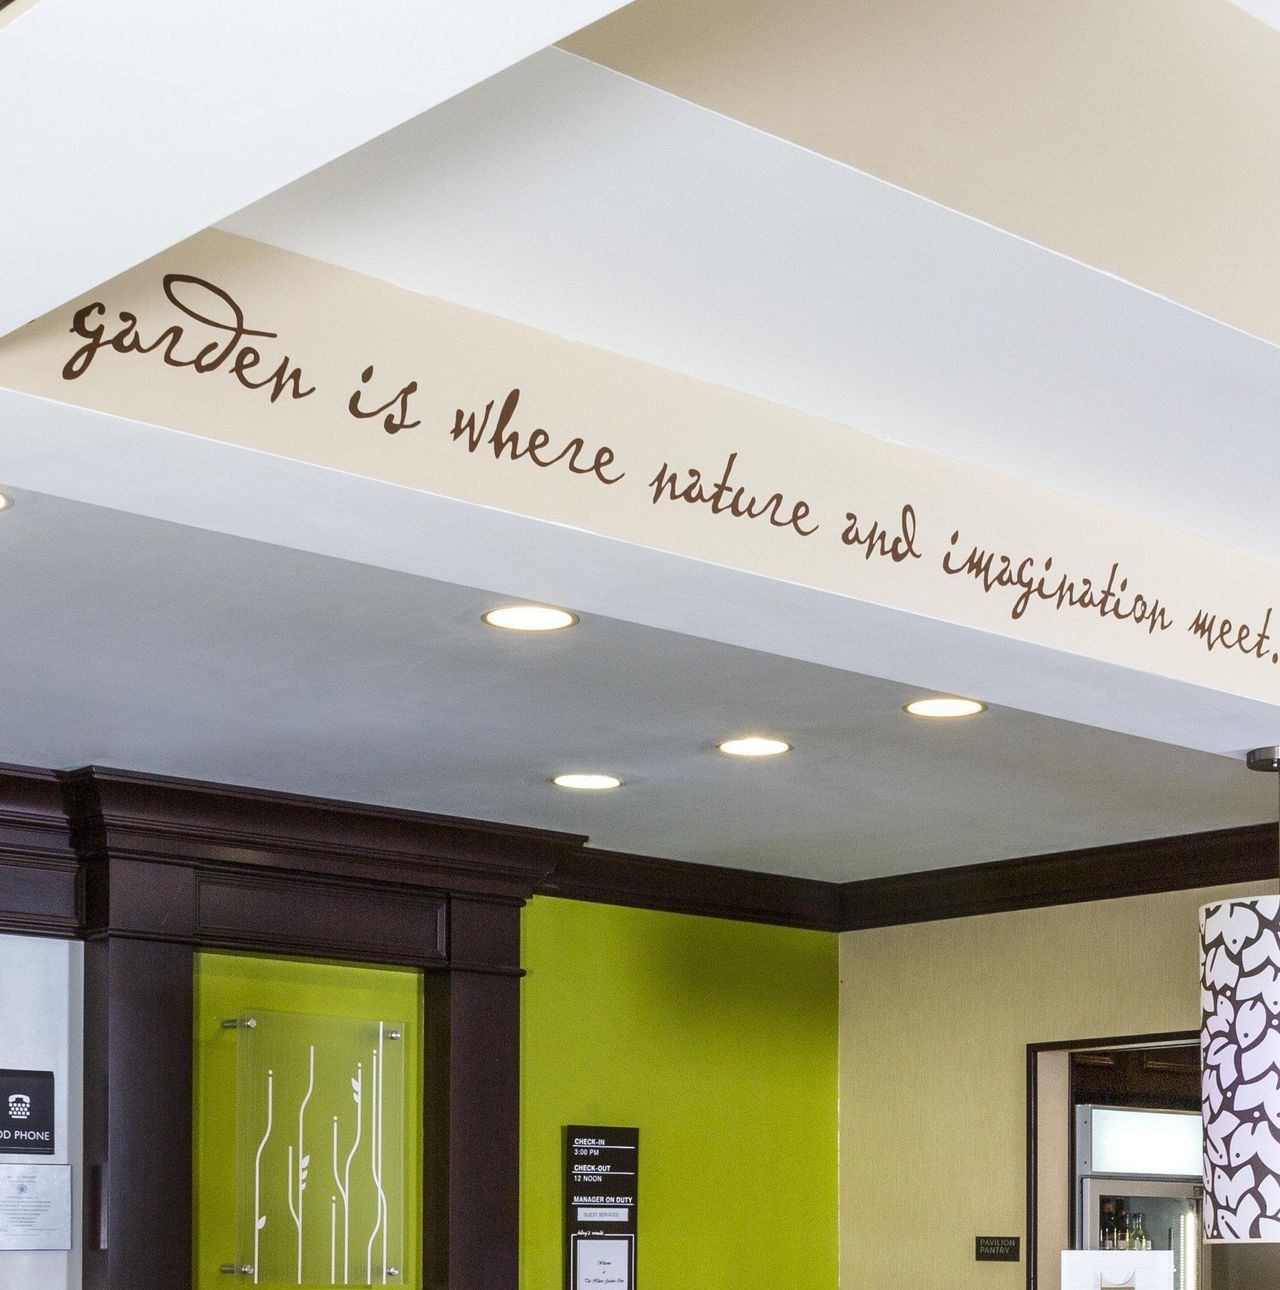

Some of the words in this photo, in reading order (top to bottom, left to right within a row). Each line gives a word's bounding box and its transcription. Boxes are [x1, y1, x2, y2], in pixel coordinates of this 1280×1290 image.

[61, 273, 317, 404] garden
[348, 365, 422, 435] is
[449, 388, 626, 485] where
[648, 452, 820, 537] nature
[841, 504, 922, 563] and
[942, 530, 1173, 624] imagination
[1187, 607, 1280, 665] meet.
[14, 1130, 50, 1141] PHONE
[574, 1138, 605, 1146] CHECK-IN
[573, 1164, 611, 1172] CHECK-OUT
[583, 1175, 602, 1183] NOON
[979, 1238, 1016, 1247] PAVILION
[979, 1246, 1010, 1254] PANTRY
